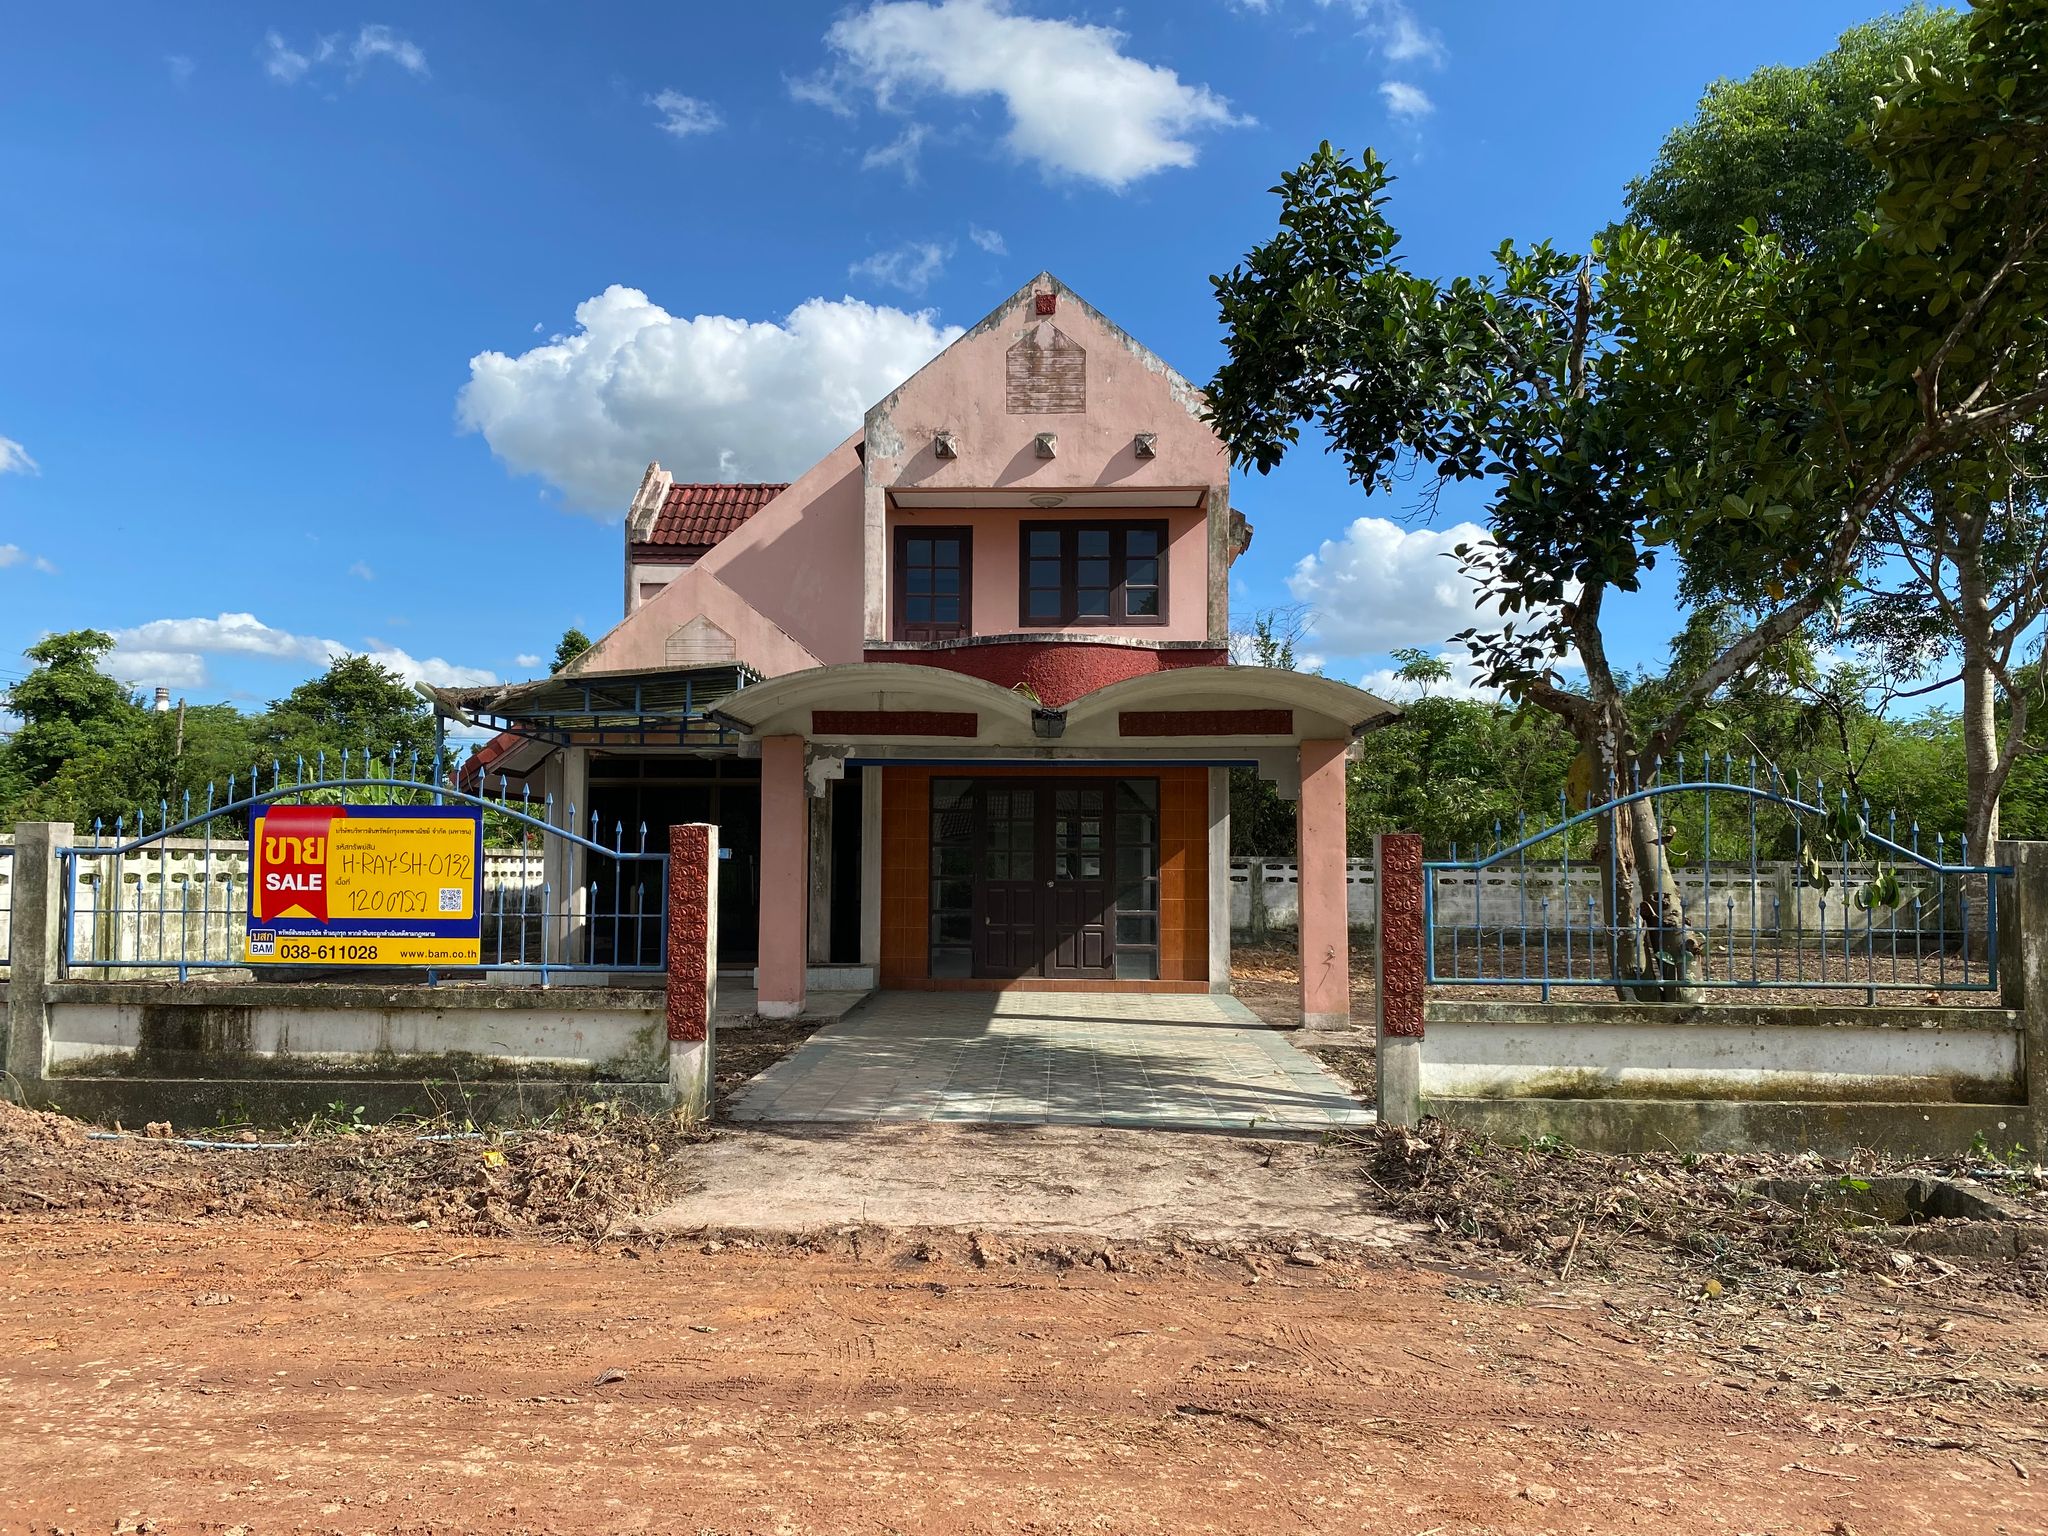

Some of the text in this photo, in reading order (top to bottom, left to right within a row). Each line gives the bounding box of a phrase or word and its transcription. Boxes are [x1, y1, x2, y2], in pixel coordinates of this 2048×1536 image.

[265, 836, 325, 865] ขาย
[343, 851, 473, 880] H-RAY-SH-0132
[265, 872, 323, 891] SALE
[252, 931, 273, 942] บสก
[252, 944, 273, 953] BAM
[280, 944, 378, 960] 038-611028
[400, 949, 477, 959] www.bam.co.th
